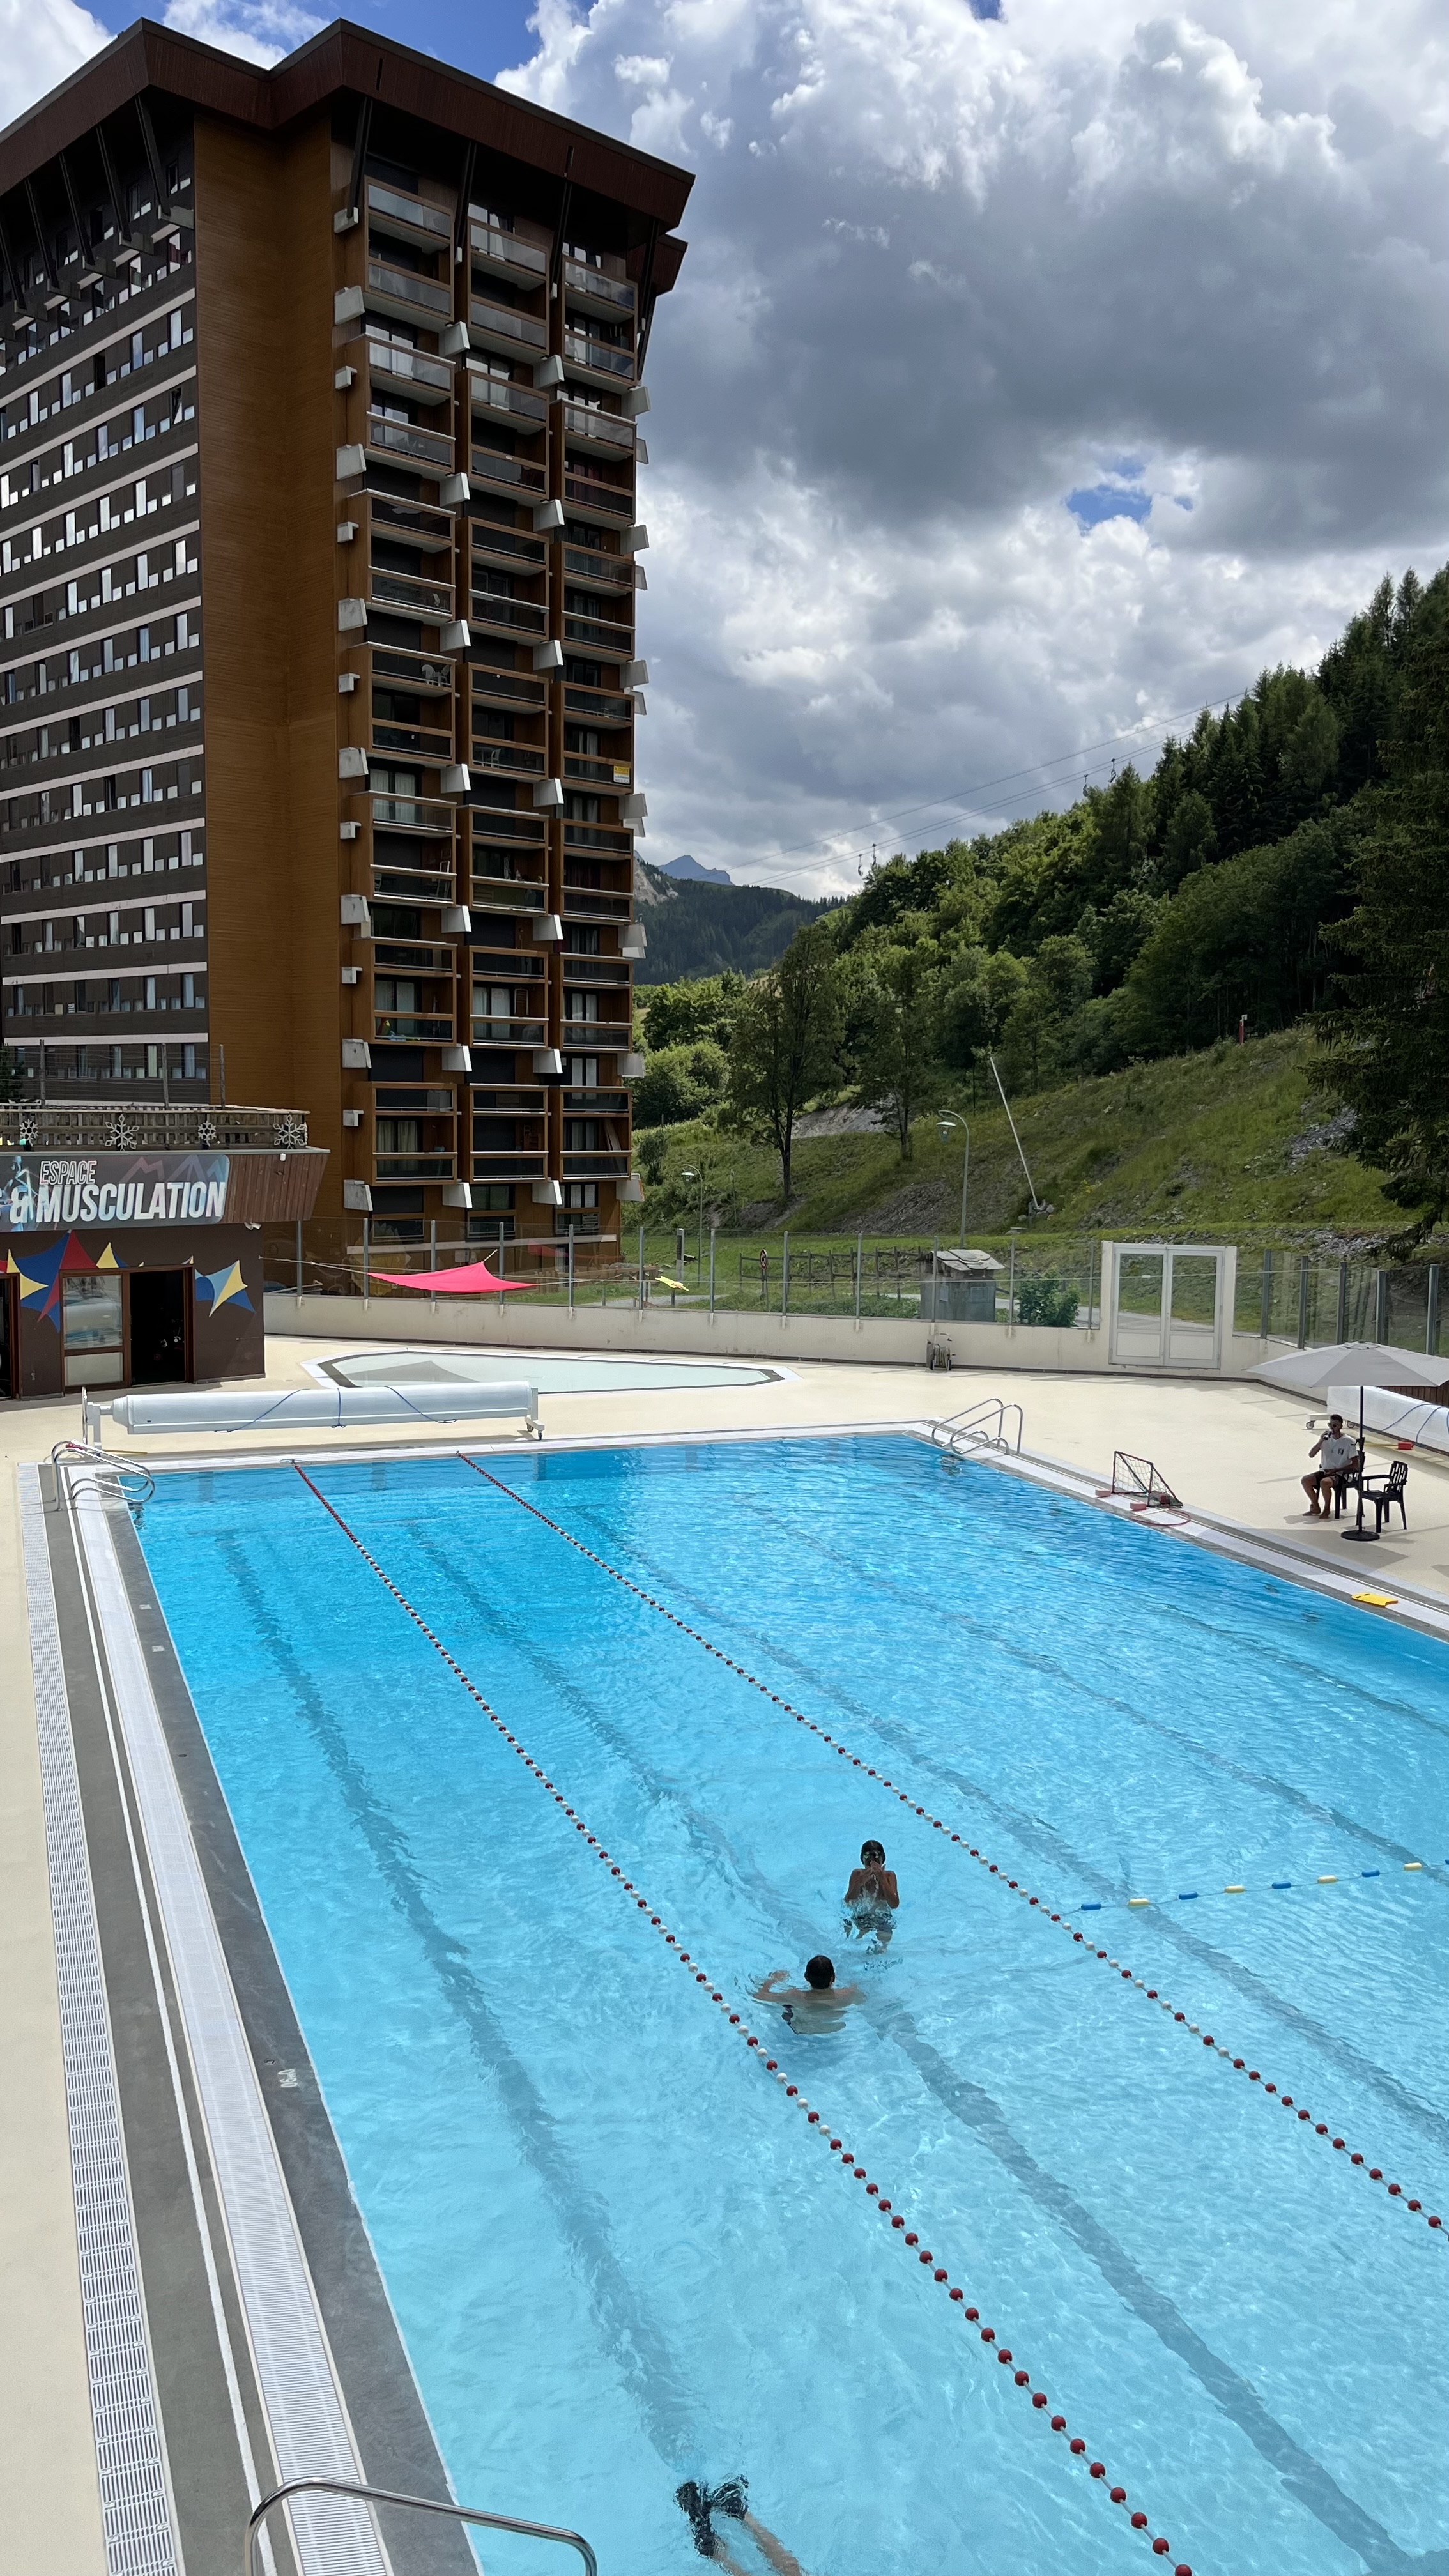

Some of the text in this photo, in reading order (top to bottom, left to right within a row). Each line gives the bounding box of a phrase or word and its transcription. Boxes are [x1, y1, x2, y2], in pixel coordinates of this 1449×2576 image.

[40, 1160, 97, 1185] ESPACE
[10, 1184, 28, 1224] &
[35, 1181, 226, 1223] MUSCULATION
